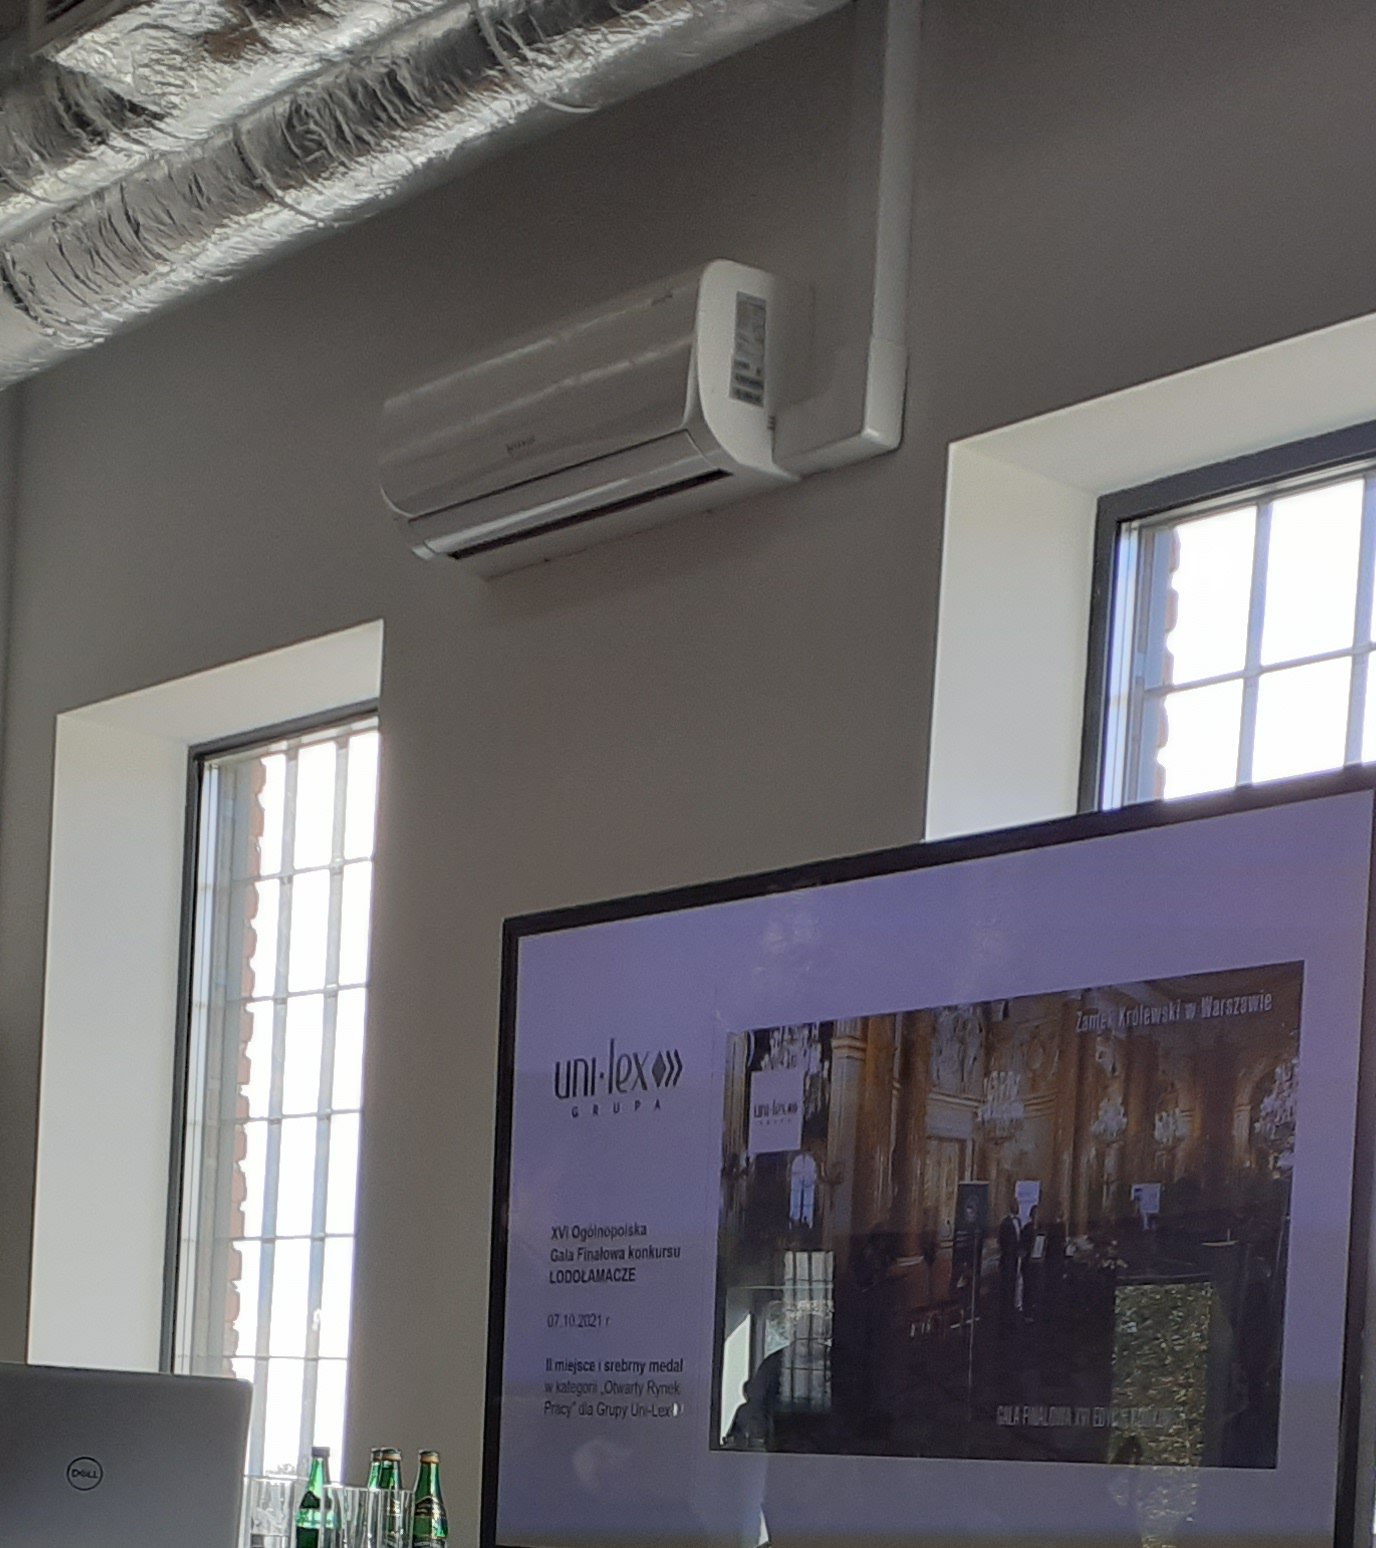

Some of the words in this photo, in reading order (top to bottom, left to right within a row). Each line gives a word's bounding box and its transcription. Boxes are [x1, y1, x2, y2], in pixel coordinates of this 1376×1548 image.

[1201, 989, 1273, 1019] Warszawie
[571, 1099, 661, 1118] GRUPA
[551, 1225, 569, 1240] XVI
[571, 1222, 647, 1242] Ogólnopolska
[550, 1248, 574, 1263] Gala
[577, 1246, 625, 1261] Finałowa
[627, 1245, 681, 1260] konkursu
[549, 1267, 636, 1284] LODOŁAMACZE
[555, 1358, 596, 1375] miejsce
[604, 1358, 646, 1375] srebrny
[649, 1358, 683, 1372] medal
[647, 1379, 681, 1398] Rynek
[578, 1402, 593, 1416] dla
[596, 1402, 628, 1420] Grupy
